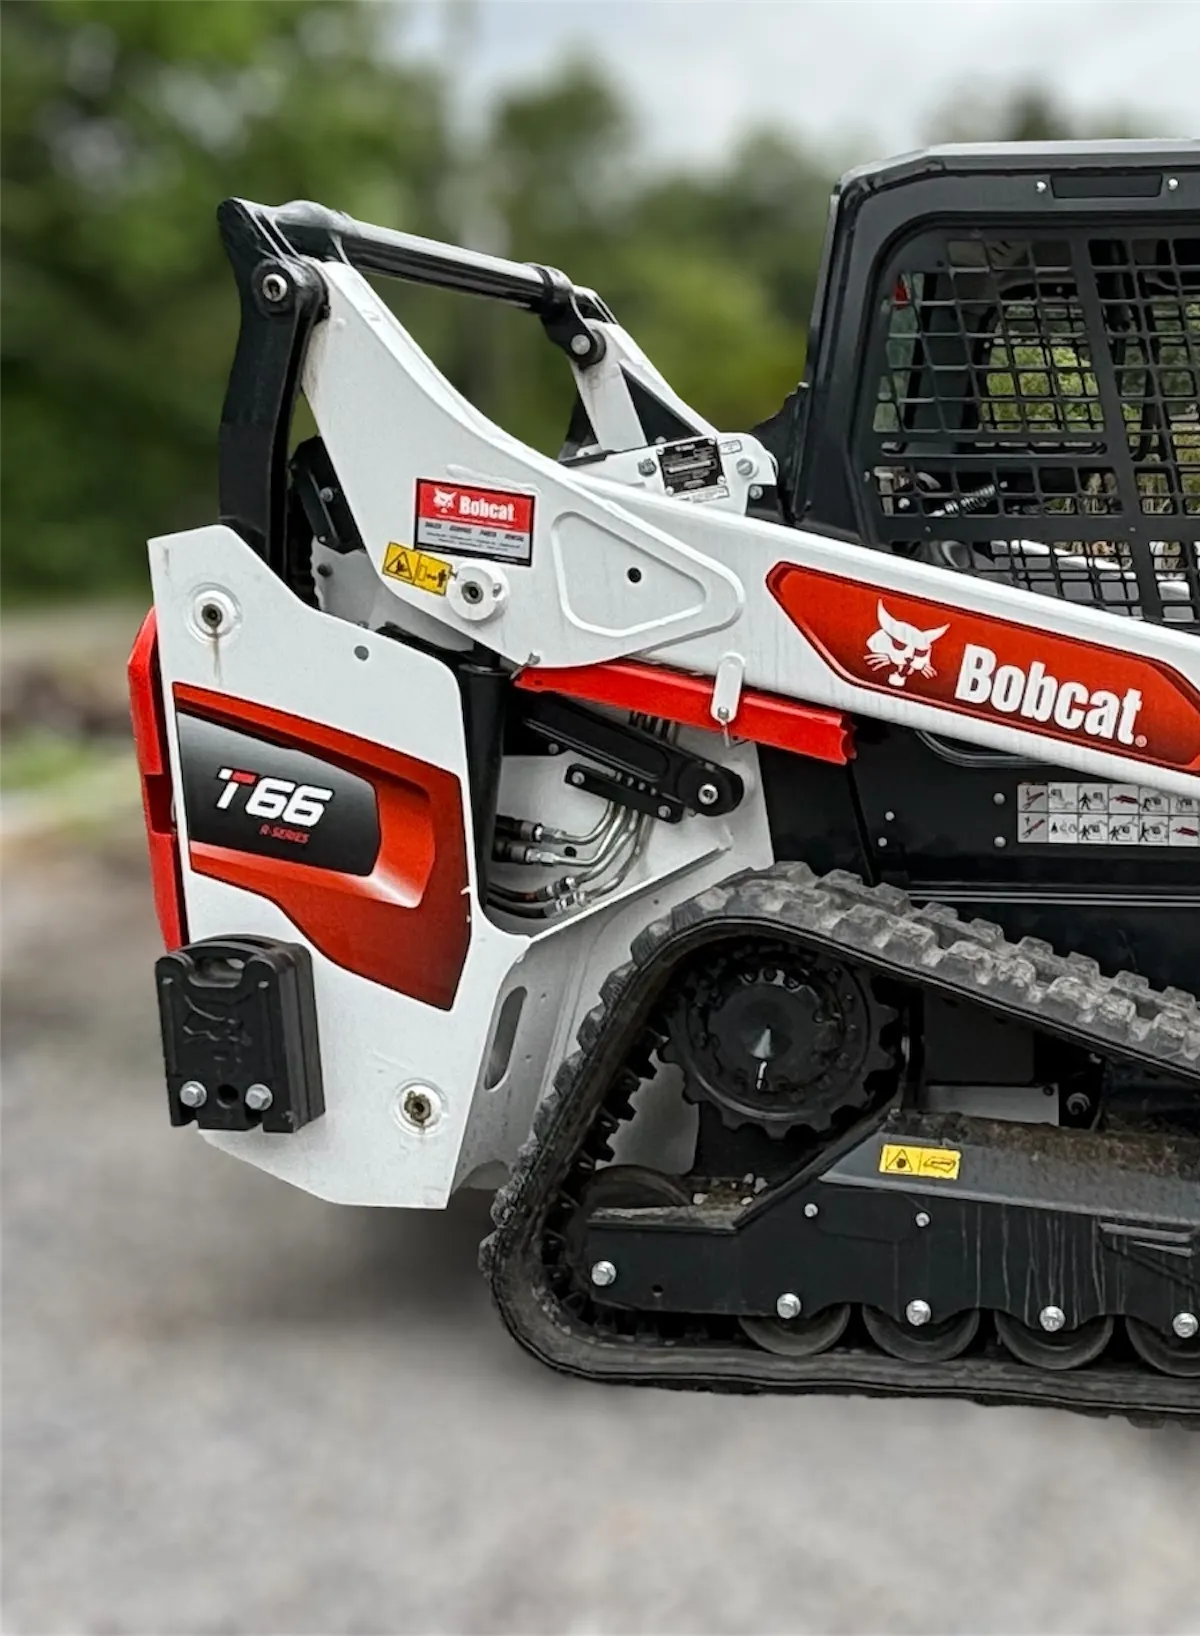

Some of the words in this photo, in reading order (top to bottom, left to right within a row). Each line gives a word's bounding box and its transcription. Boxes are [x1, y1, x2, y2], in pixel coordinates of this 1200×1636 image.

[458, 495, 516, 522] Bobcat
[954, 643, 1143, 746] Bobcat
[216, 768, 334, 828] T66
